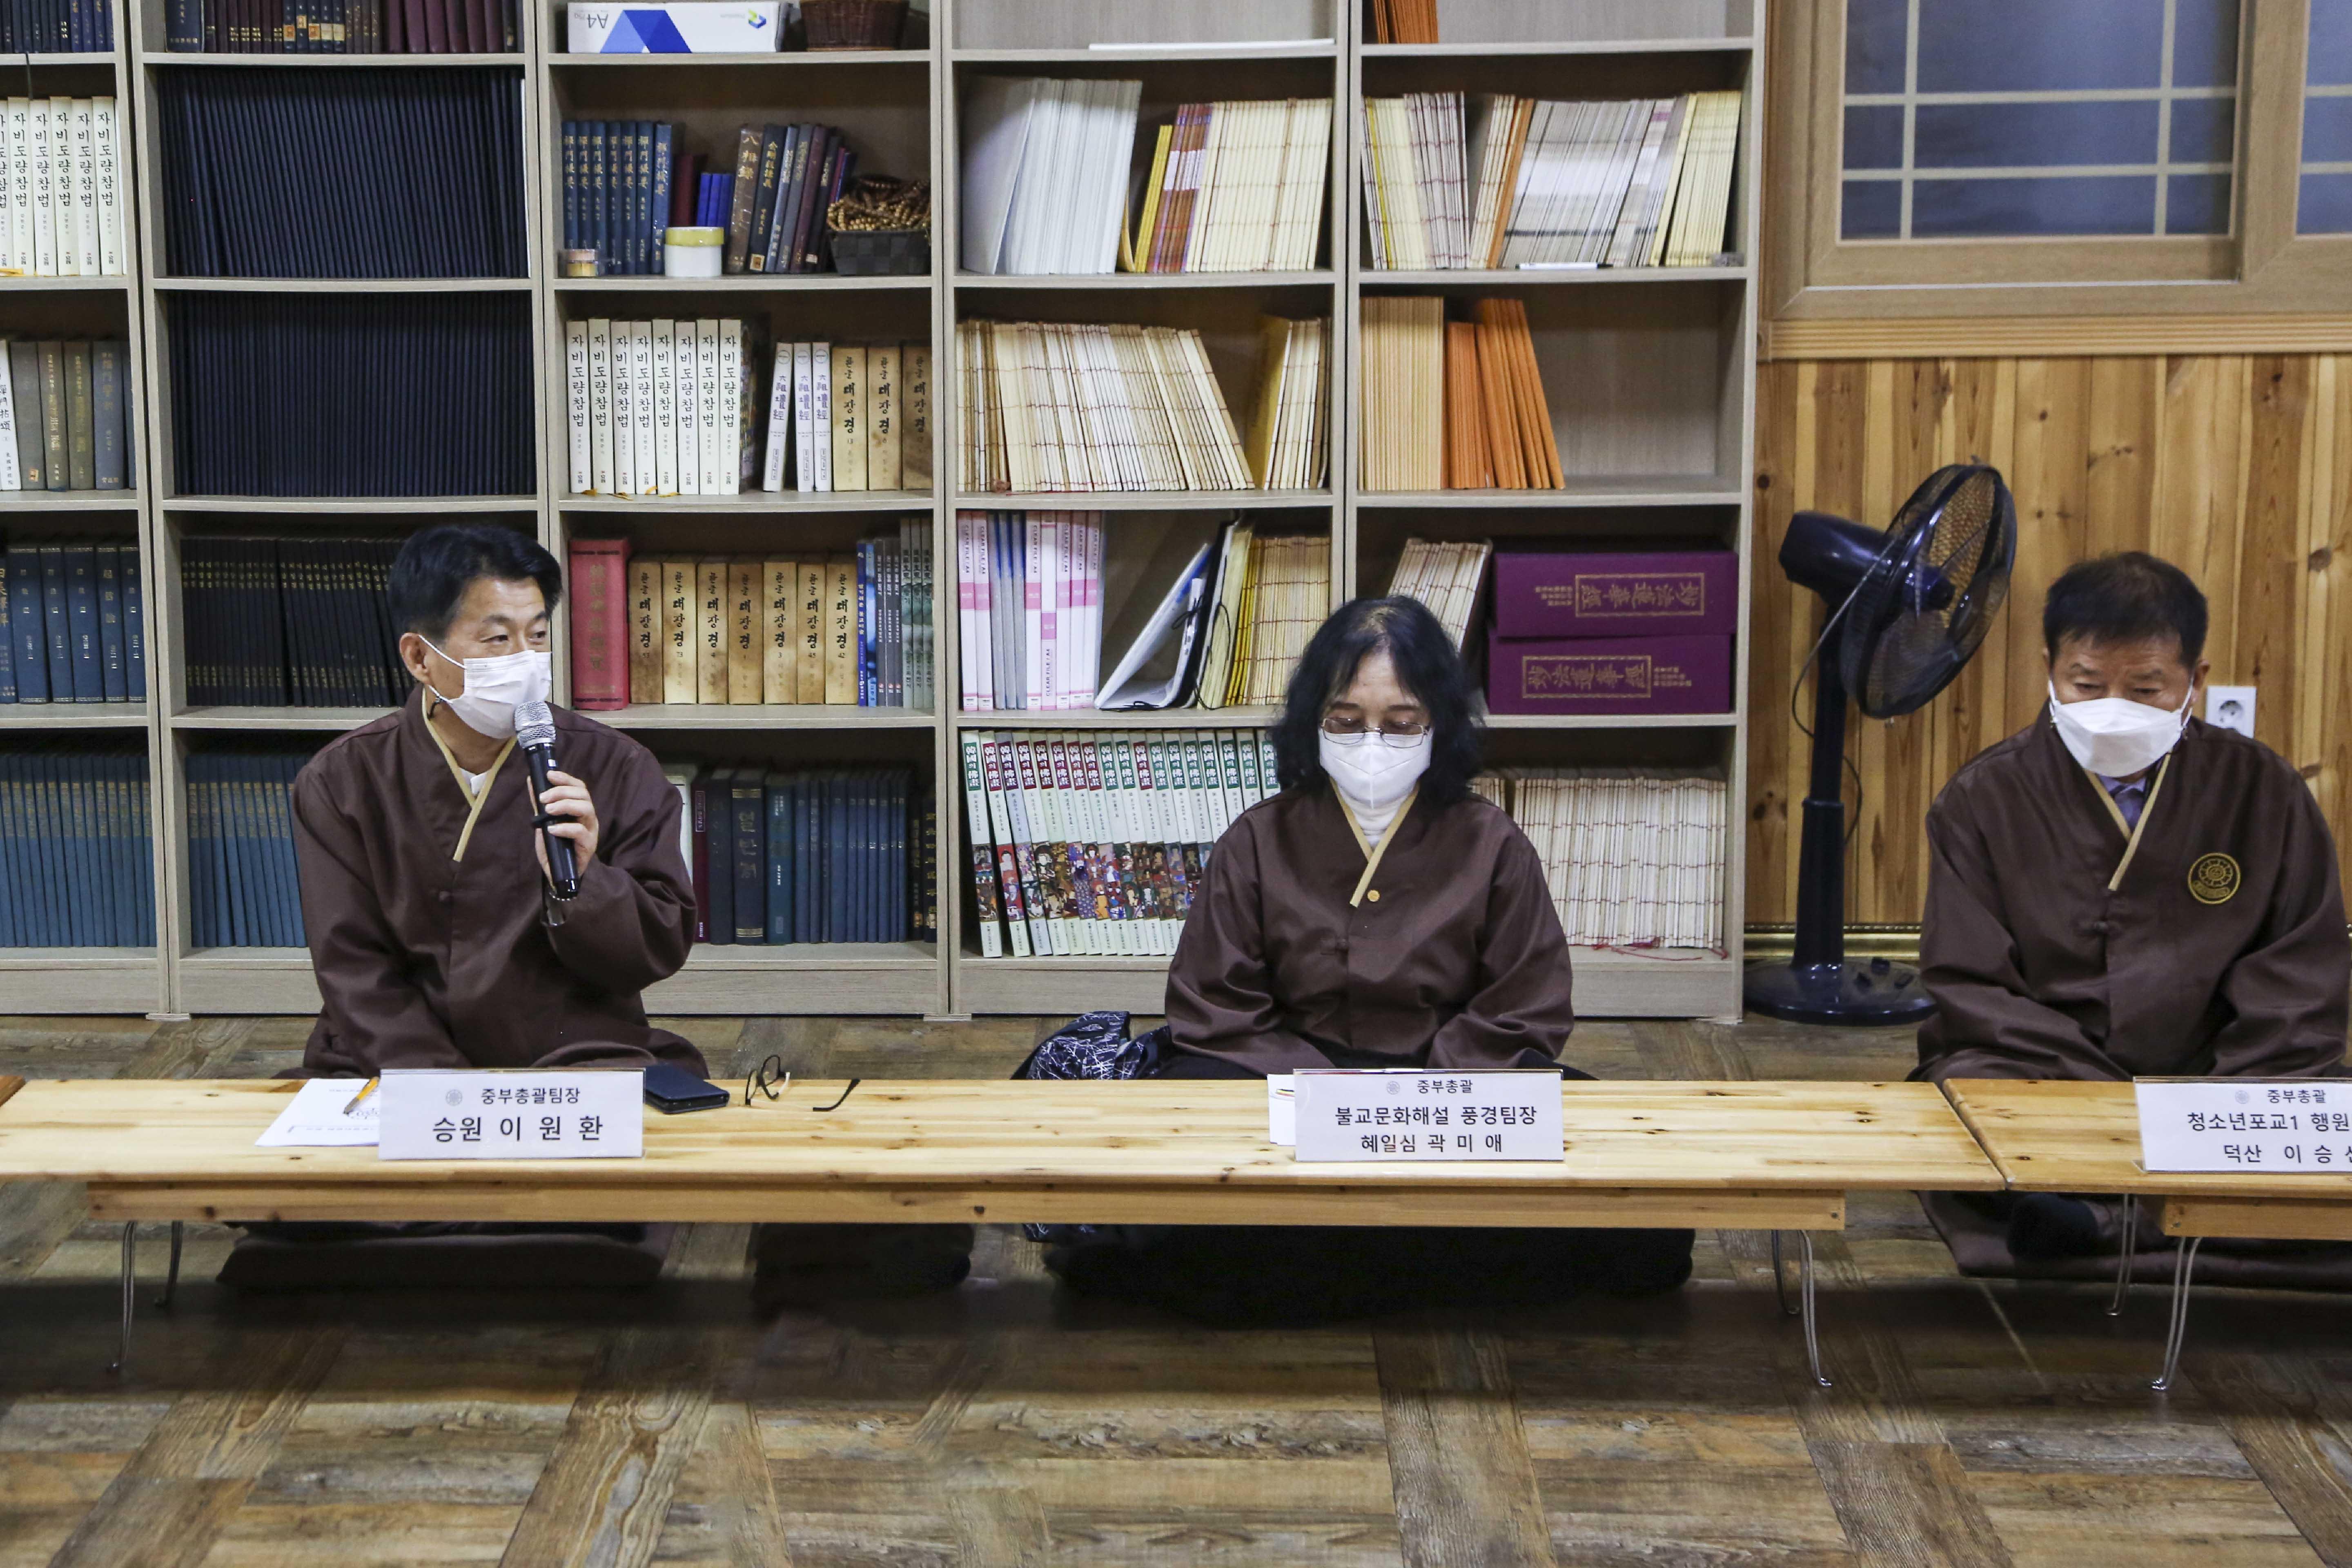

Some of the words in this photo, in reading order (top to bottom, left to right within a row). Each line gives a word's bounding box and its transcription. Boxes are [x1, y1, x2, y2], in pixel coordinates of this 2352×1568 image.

[587, 13, 608, 29] A4
[13, 113, 28, 207] 자비도량참법
[35, 113, 49, 207] 자비도량참법
[56, 112, 71, 207] 자비도량참법
[78, 113, 93, 207] 자비도량참법
[98, 111, 114, 207] 자비도량참법
[572, 334, 585, 427] 자비도량참법
[593, 334, 607, 426] 자비도량참법
[616, 336, 630, 428] 자비도량참법
[637, 336, 650, 428] 자비도량참법
[657, 334, 671, 427] 자비도량참법
[680, 336, 693, 428] 자비도량참법
[702, 335, 715, 427] 자비도량참법
[724, 335, 736, 427] 자비도량참법
[965, 565, 970, 573] A4
[981, 566, 986, 575] A4
[1581, 581, 1699, 609] 妙法蓮華經
[1528, 662, 1646, 691] 妙法蓮華經
[481, 1087, 581, 1105] 중부총괄팀장
[1335, 1106, 1449, 1125] 불교문화해설
[1460, 1106, 1537, 1125] 풍경팀장
[1417, 1079, 1473, 1094] 중부총괄
[2267, 1089, 2326, 1103] 중부총괄
[432, 1116, 481, 1143] 승원
[500, 1117, 521, 1141] 이
[539, 1116, 561, 1140] 원
[579, 1116, 603, 1141] 환
[1361, 1134, 1415, 1153] 혜일심
[1428, 1134, 1446, 1152] 곽
[1457, 1134, 1473, 1152] 미
[1485, 1134, 1503, 1153] 애
[2187, 1112, 2298, 1131] 청소년포교1
[2224, 1144, 2261, 1163] 덕산
[2284, 1145, 2301, 1163] 이
[2314, 1145, 2332, 1163] 승
